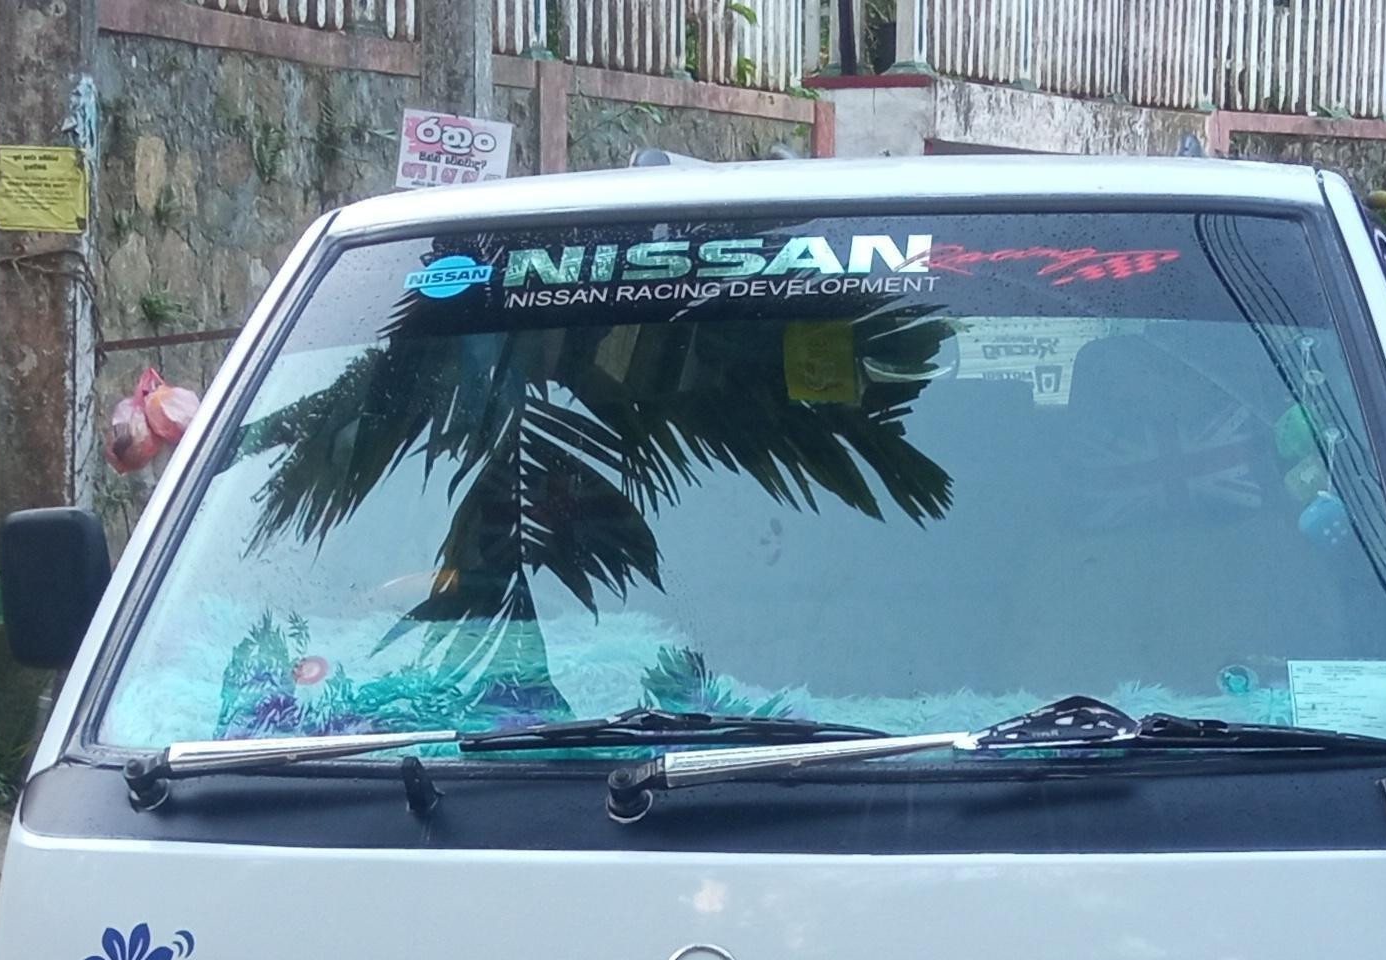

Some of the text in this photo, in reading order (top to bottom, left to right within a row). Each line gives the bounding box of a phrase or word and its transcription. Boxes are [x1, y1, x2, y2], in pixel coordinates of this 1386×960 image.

[407, 267, 489, 286] NISSAN
[503, 234, 933, 287] NISSAN
[508, 275, 941, 309] NISSAN RACING DEVELOPMENT
